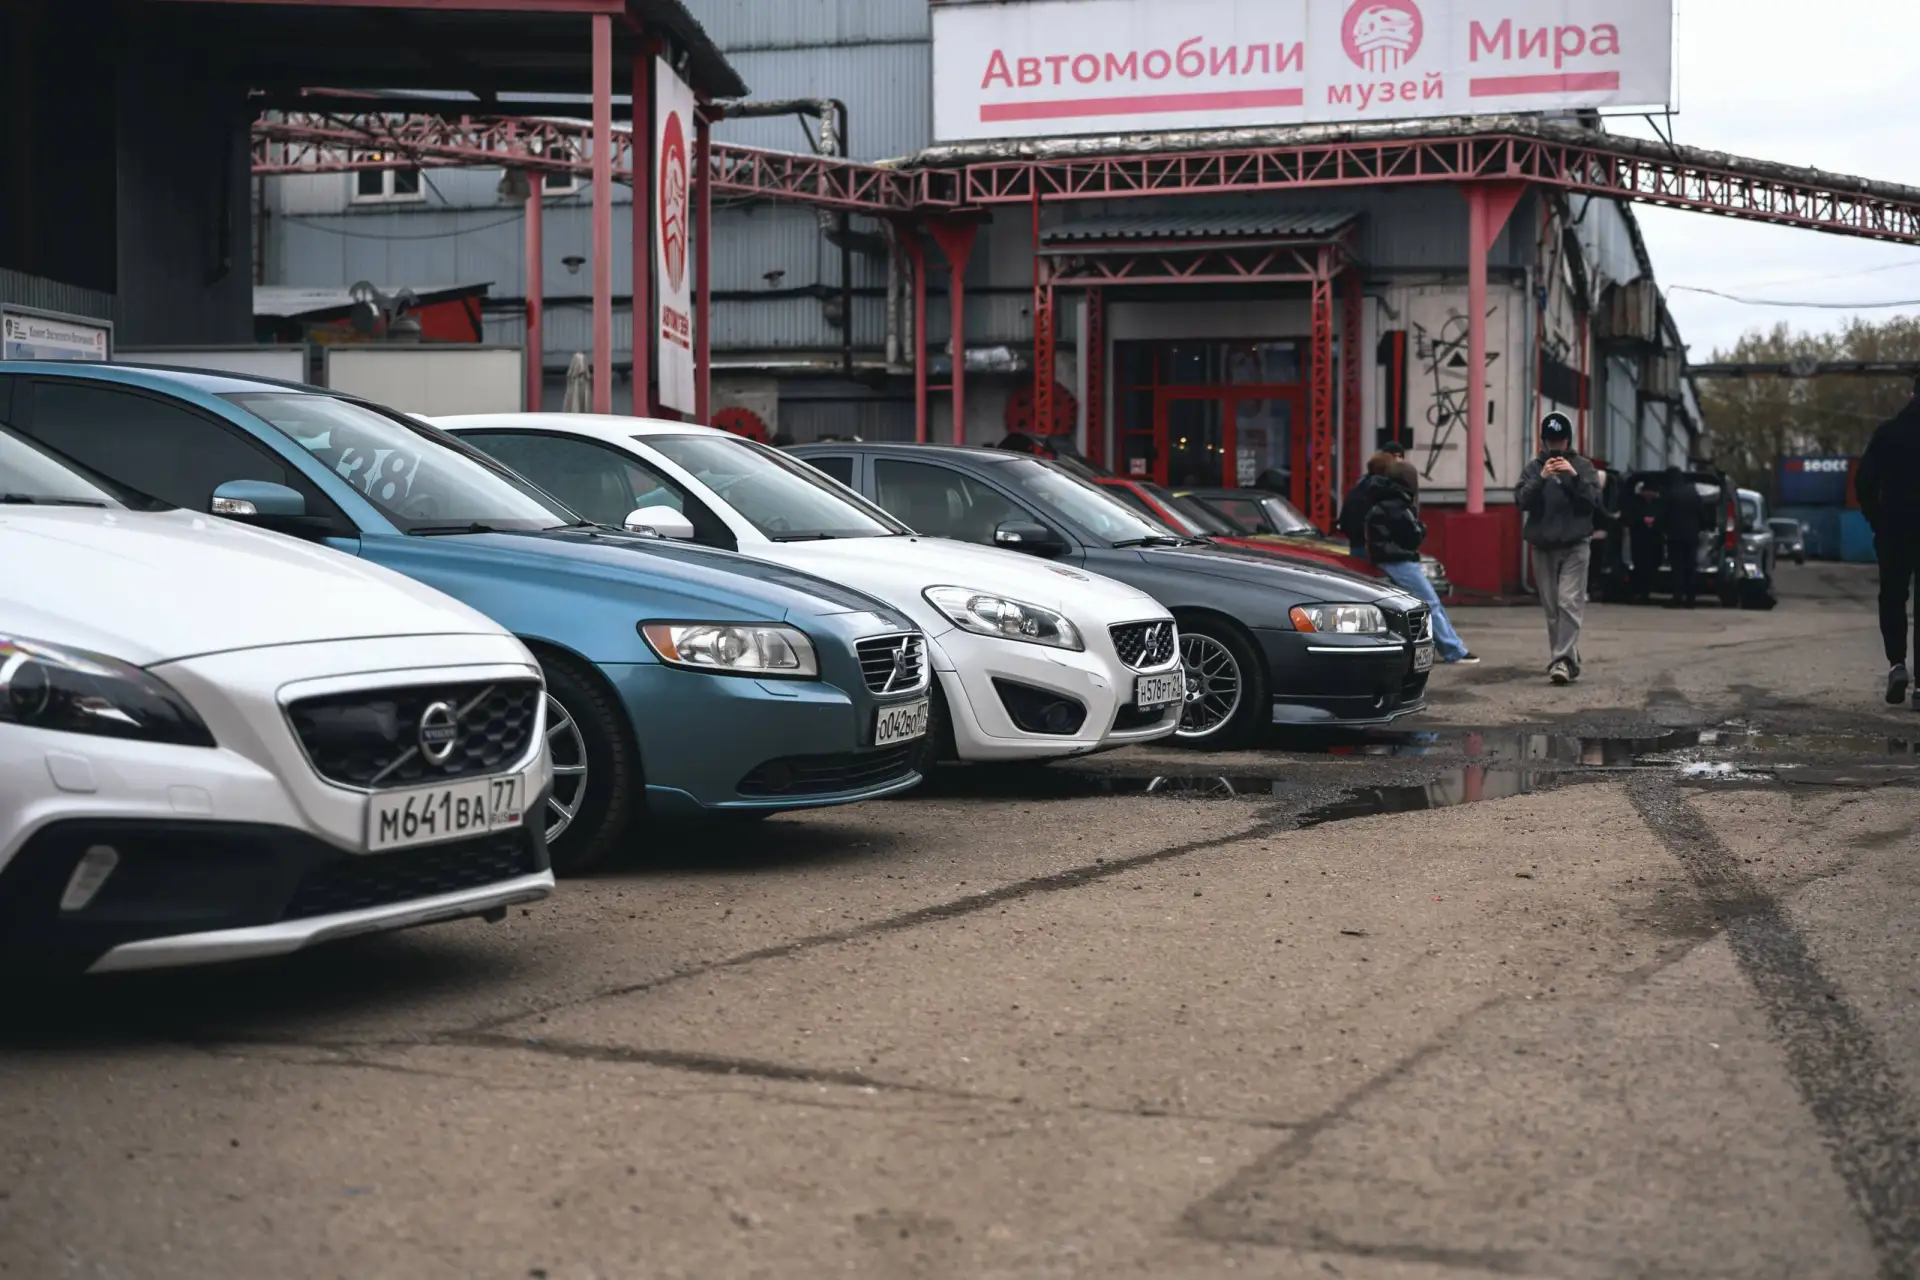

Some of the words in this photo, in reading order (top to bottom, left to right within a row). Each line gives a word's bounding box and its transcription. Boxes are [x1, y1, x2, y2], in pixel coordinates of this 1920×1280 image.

[980, 36, 1304, 89] Автомобили
[1468, 18, 1621, 69] Мира
[1326, 71, 1444, 111] музей
